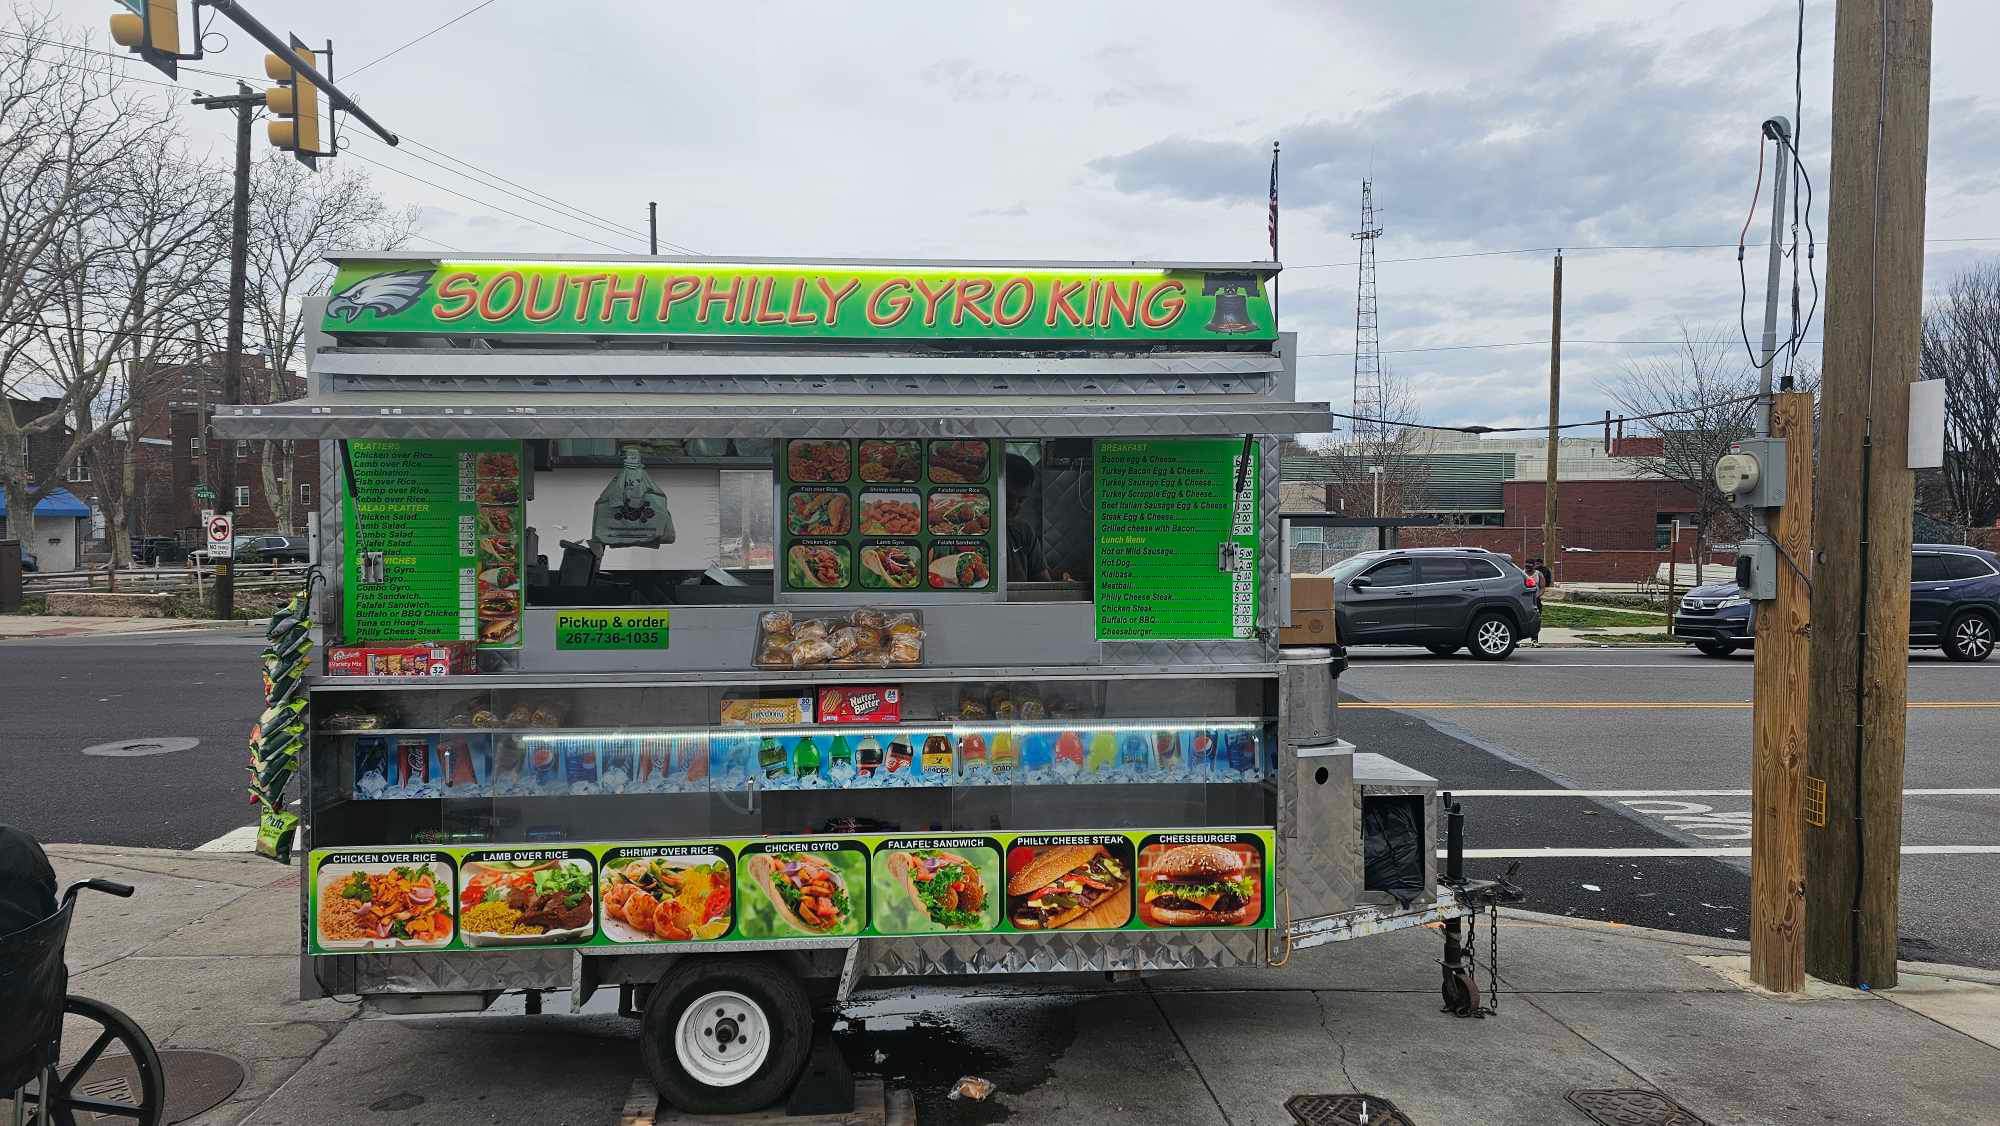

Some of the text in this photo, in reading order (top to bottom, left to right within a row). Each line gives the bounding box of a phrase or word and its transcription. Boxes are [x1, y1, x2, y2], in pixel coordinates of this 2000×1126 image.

[432, 271, 1187, 328] SOUTH PHILLY GYRO KING
[559, 616, 666, 630] Pickup & order
[565, 632, 659, 644] 267-736-1035
[432, 666, 444, 674] 32
[849, 692, 877, 707] Nutter
[854, 699, 881, 715] Butter
[888, 839, 984, 849] FALAFEL SANDWICH
[1017, 835, 1124, 846] PHILLY CHEESE STEAK
[1159, 834, 1237, 844] CHEESEBURGER
[620, 846, 714, 857] SHRIMP OVER RICE
[764, 842, 839, 853] CHICKEN GYRO
[333, 853, 437, 864] CHICKEN OVER RICE
[482, 850, 569, 861] LAMB OVER RICE
